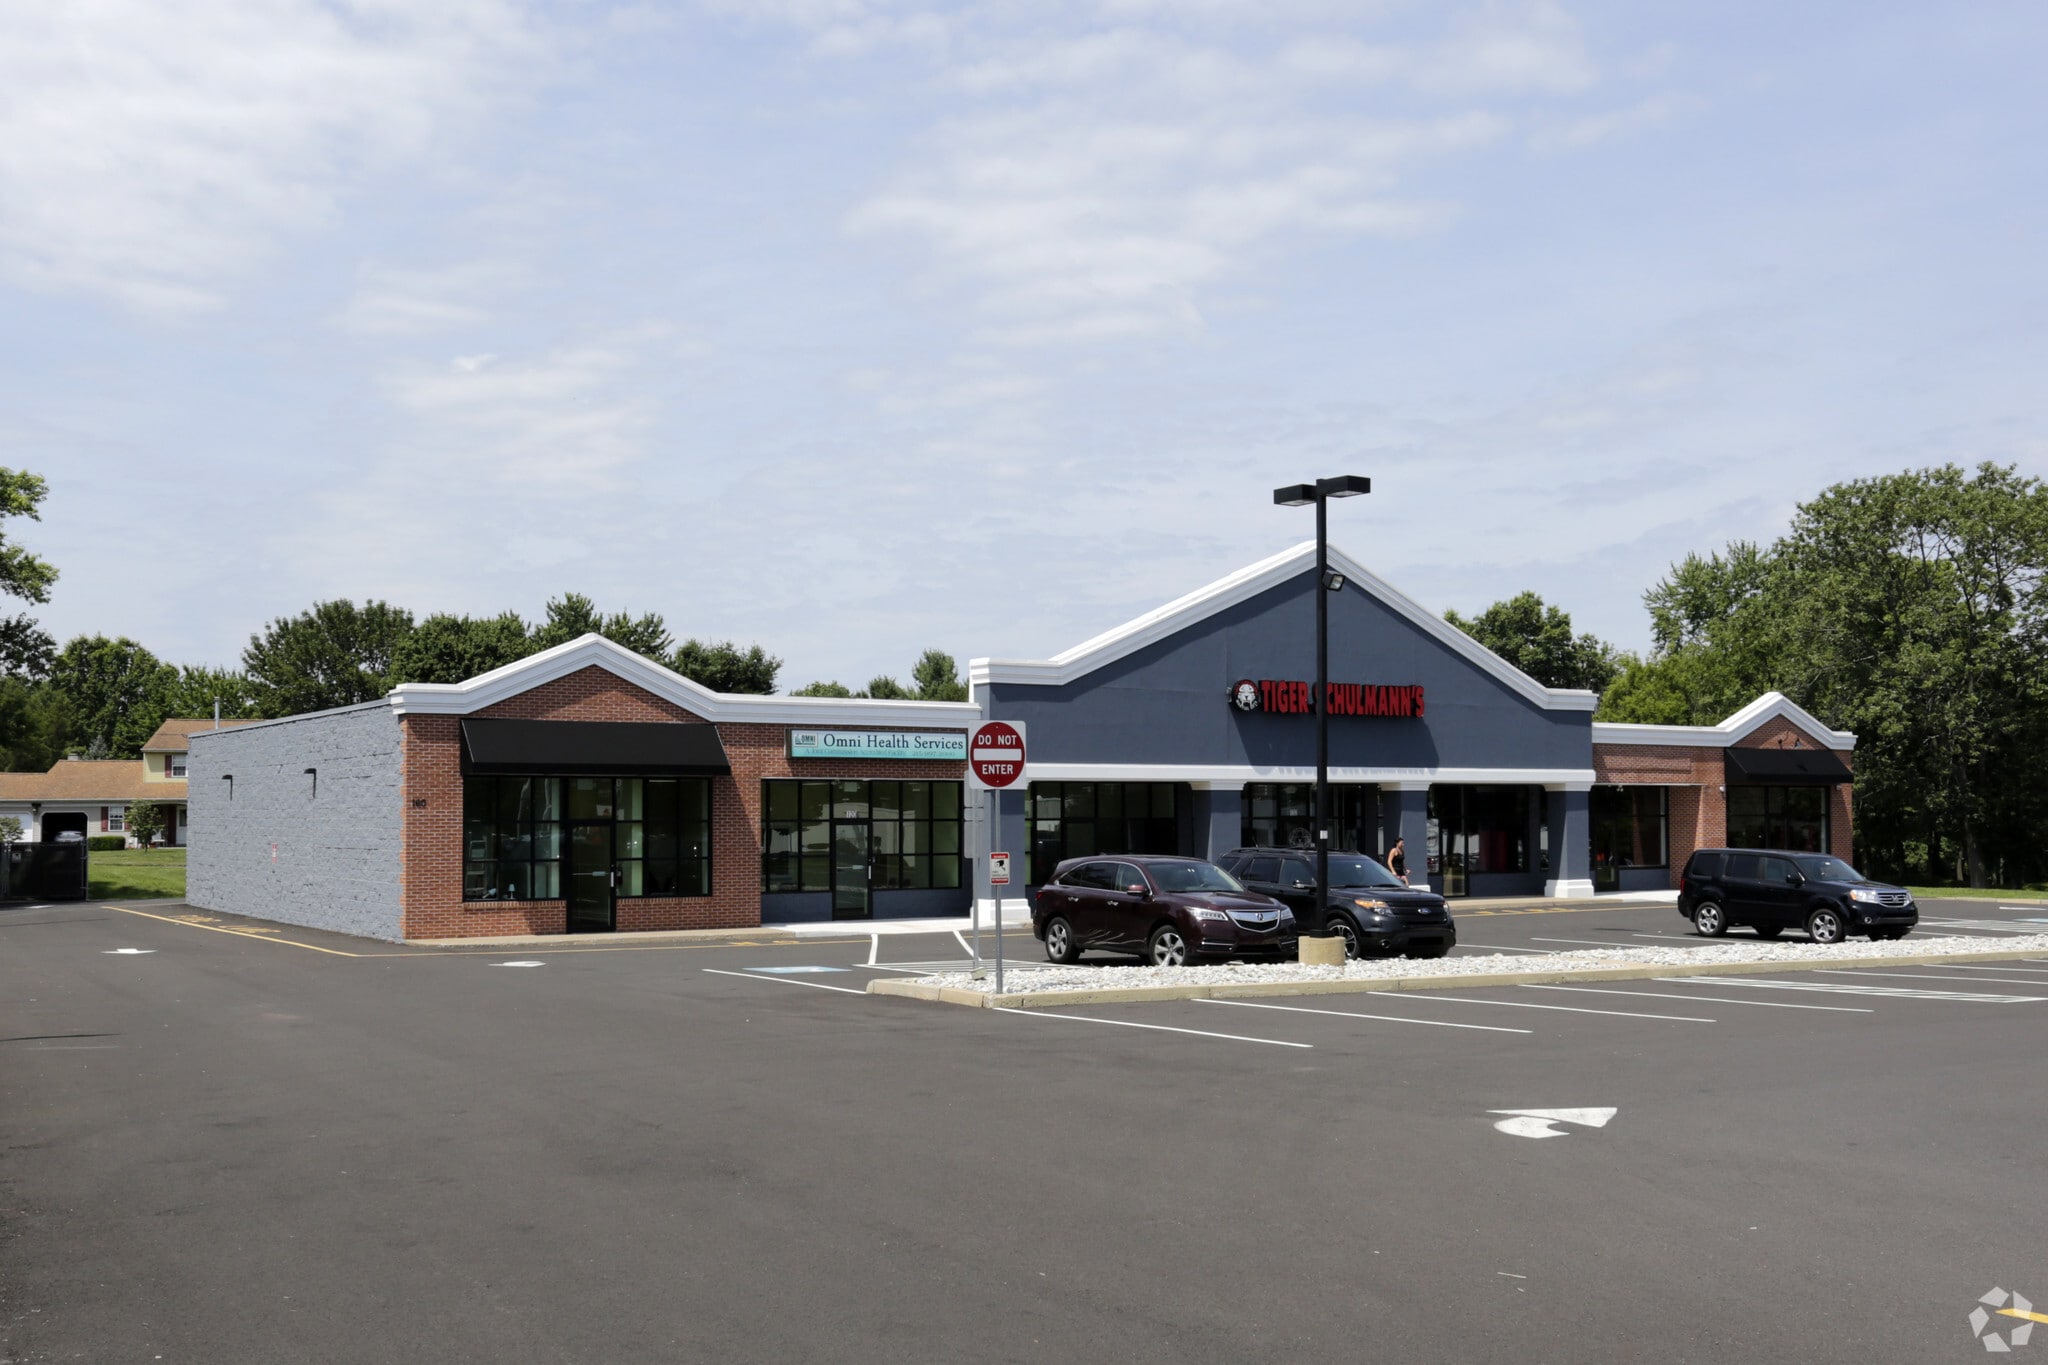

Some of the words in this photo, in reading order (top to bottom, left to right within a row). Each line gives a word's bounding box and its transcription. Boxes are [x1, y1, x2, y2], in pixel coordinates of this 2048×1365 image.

[1260, 680, 1309, 713] TIGER
[1315, 682, 1425, 717] CHULMANN'S
[801, 734, 816, 743] OMNI
[823, 733, 862, 748] Omni
[866, 734, 910, 749] Health
[914, 735, 964, 750] Services
[978, 734, 992, 746] DO
[997, 734, 1017, 746] NOT
[981, 763, 1014, 775] ENTER
